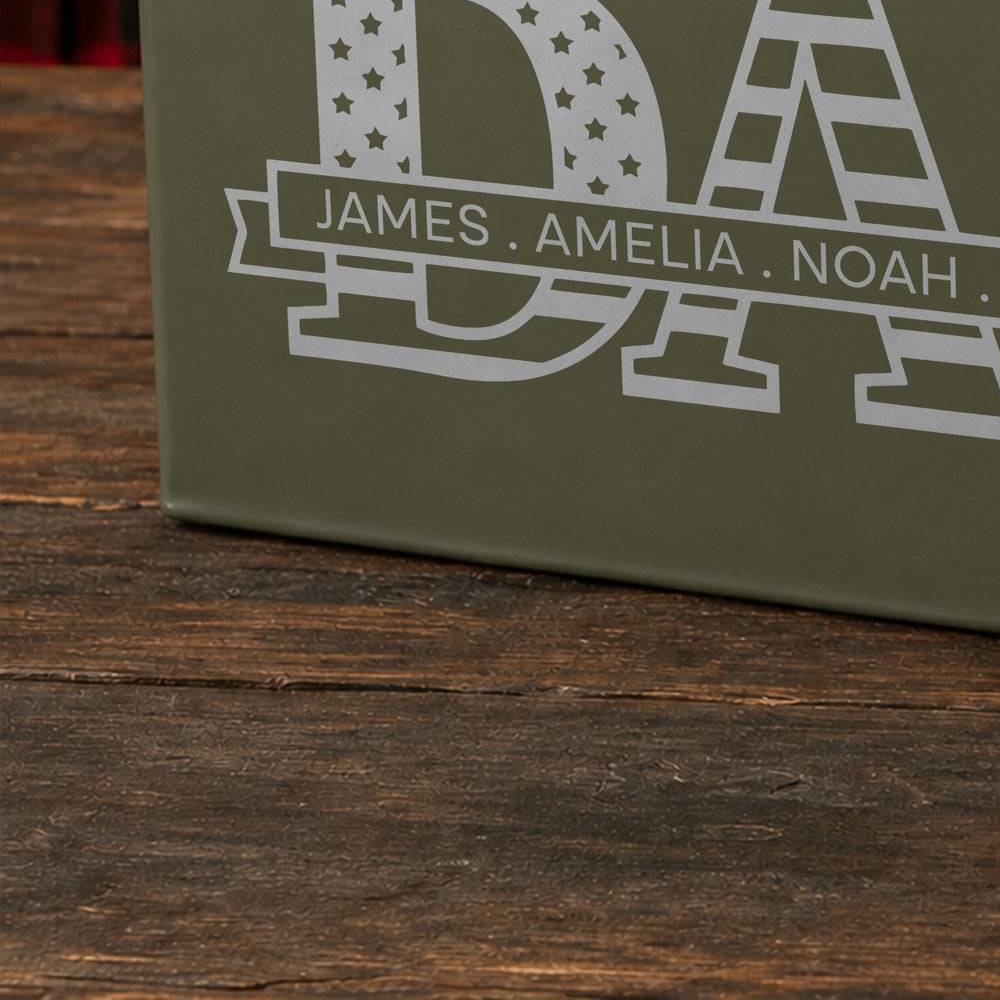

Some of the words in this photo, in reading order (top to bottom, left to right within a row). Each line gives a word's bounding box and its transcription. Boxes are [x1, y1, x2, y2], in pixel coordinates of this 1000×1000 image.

[316, 188, 489, 246] JAMES
[535, 212, 744, 275] AMELIA
[793, 239, 957, 299] NOAH
